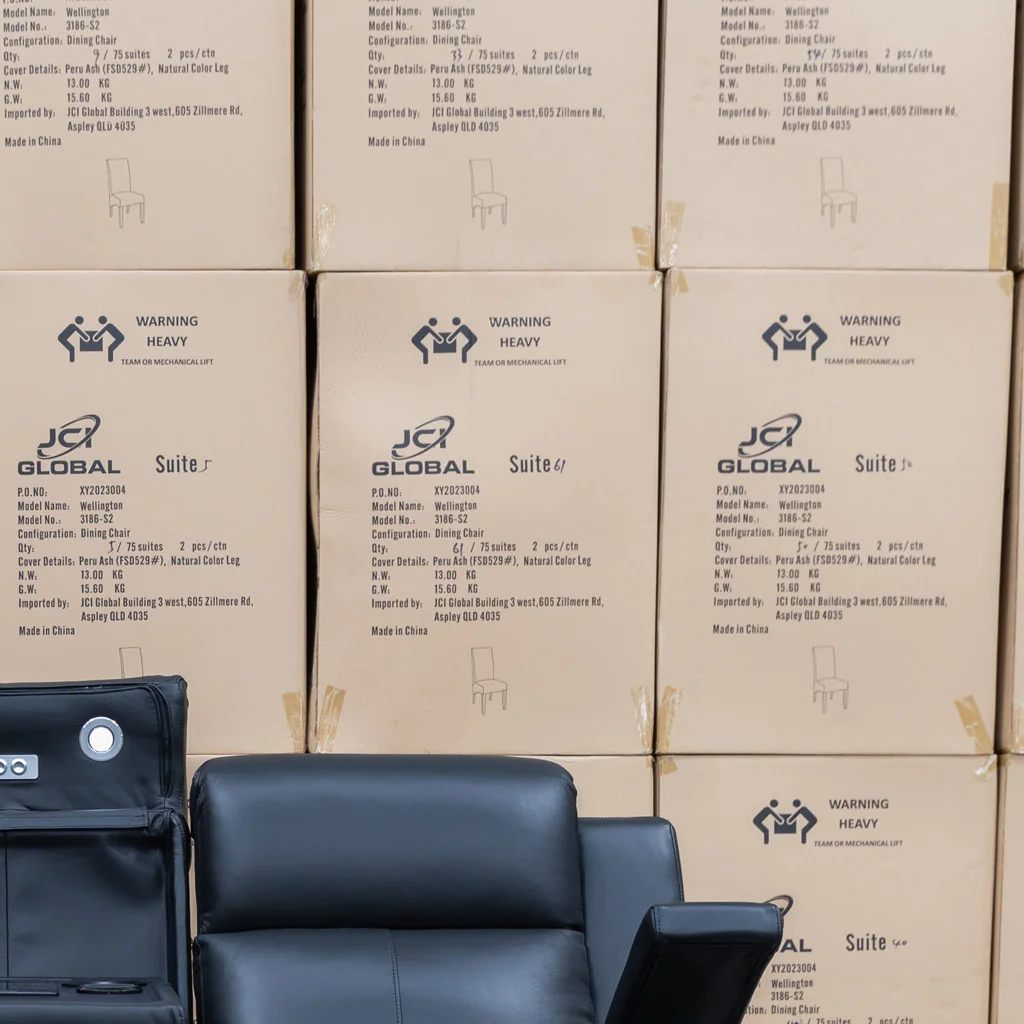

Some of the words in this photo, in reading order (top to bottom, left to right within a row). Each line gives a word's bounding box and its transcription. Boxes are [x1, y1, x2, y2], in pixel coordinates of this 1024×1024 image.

[65, 7, 110, 19] Wellington
[431, 6, 475, 18] Wellington
[785, 6, 829, 18] Wellington
[66, 34, 94, 47] Dining
[95, 34, 118, 46] Chair
[67, 121, 95, 134] Aspley
[96, 120, 113, 132] QLD
[114, 120, 136, 132] 4035
[368, 136, 390, 147] Made
[392, 136, 400, 147] in
[401, 135, 426, 147] China
[717, 135, 740, 146] Made
[742, 137, 750, 146] in
[751, 135, 776, 146] China
[135, 315, 199, 327] WARNING
[488, 316, 552, 328] WARNING
[839, 315, 901, 327] WARNING
[146, 335, 188, 347] HEAVY
[500, 336, 541, 348] HEAVY
[849, 335, 890, 347] HEAVY
[120, 358, 142, 366] TEAM
[141, 358, 153, 366] OR
[153, 358, 199, 366] MECHANICAL
[199, 358, 214, 366] LIFT
[474, 359, 495, 367] TEAM
[495, 359, 506, 367] OR
[552, 358, 567, 366] LIFT
[37, 427, 93, 449] JCI
[392, 428, 447, 449] JCI
[738, 426, 794, 447] JCI
[17, 458, 122, 476] GLOBAL
[155, 454, 198, 474] Suite
[371, 458, 476, 477] GLOBAL
[509, 454, 551, 474] Suite
[553, 458, 566, 474] 61
[717, 456, 821, 474] GLOBAL
[855, 453, 897, 473] Suite
[79, 484, 126, 496] XY2023004
[434, 484, 481, 496] XY2023004
[778, 483, 825, 495] XY2023004
[79, 500, 123, 513] Wellington
[434, 500, 478, 513] Wellington
[18, 625, 41, 636] Made
[42, 625, 51, 636] in
[52, 625, 76, 636] China
[828, 798, 889, 810] WARNING
[839, 818, 879, 829] HEAVY
[845, 932, 887, 952] Suite
[891, 938, 908, 948] 40
[771, 962, 817, 974] XY2023004
